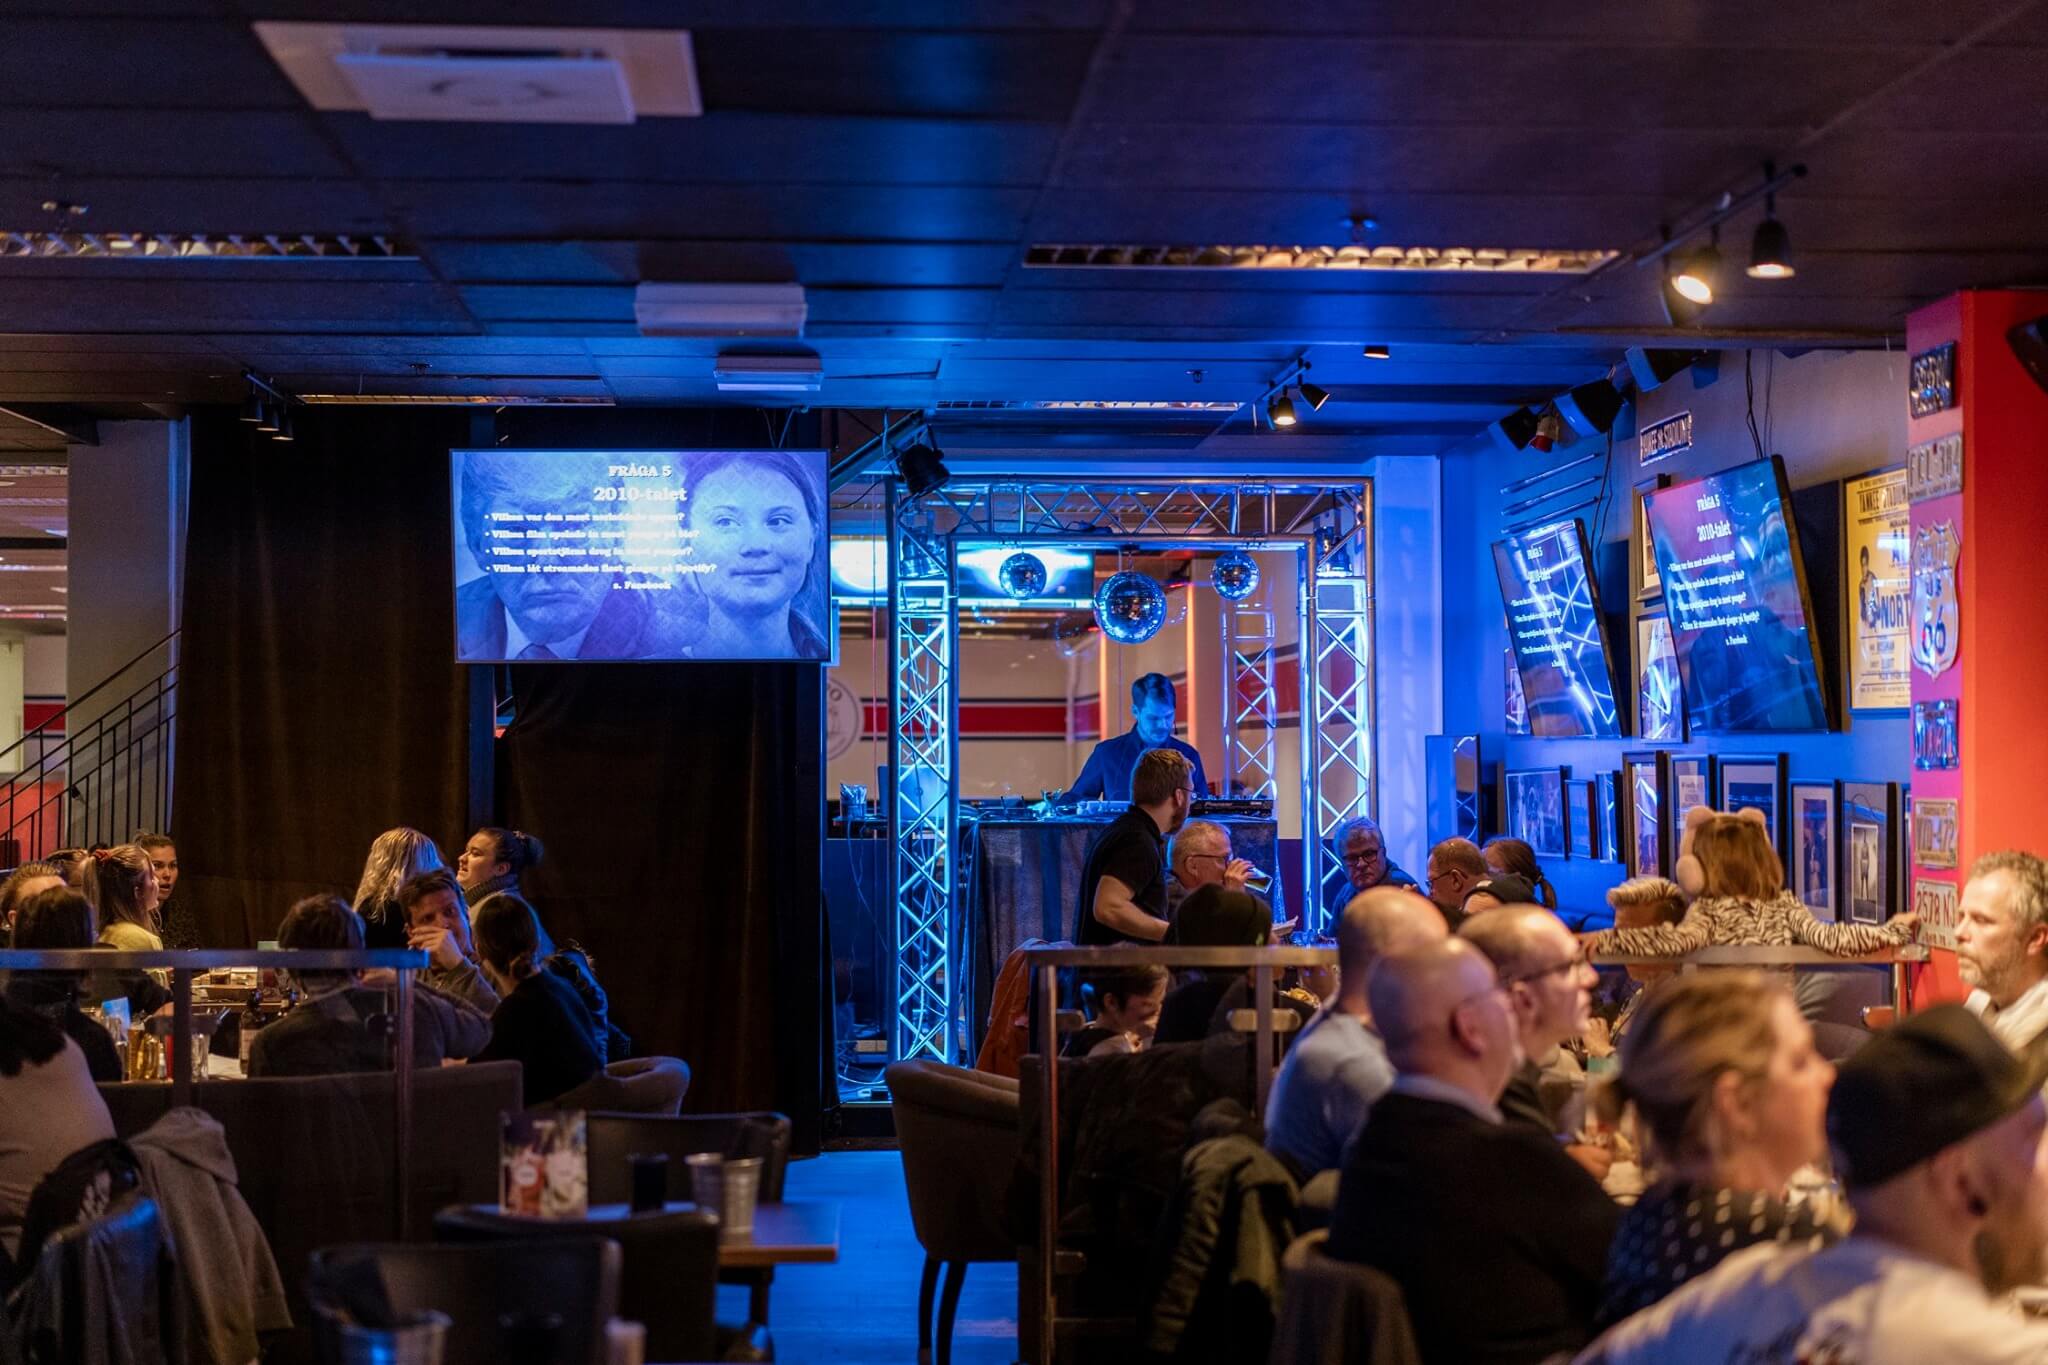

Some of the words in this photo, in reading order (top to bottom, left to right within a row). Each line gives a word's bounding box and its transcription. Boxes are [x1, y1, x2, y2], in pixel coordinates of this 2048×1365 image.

[608, 463, 658, 477] FRÅGA
[662, 465, 673, 477] 5
[593, 487, 688, 501] 2010-talet
